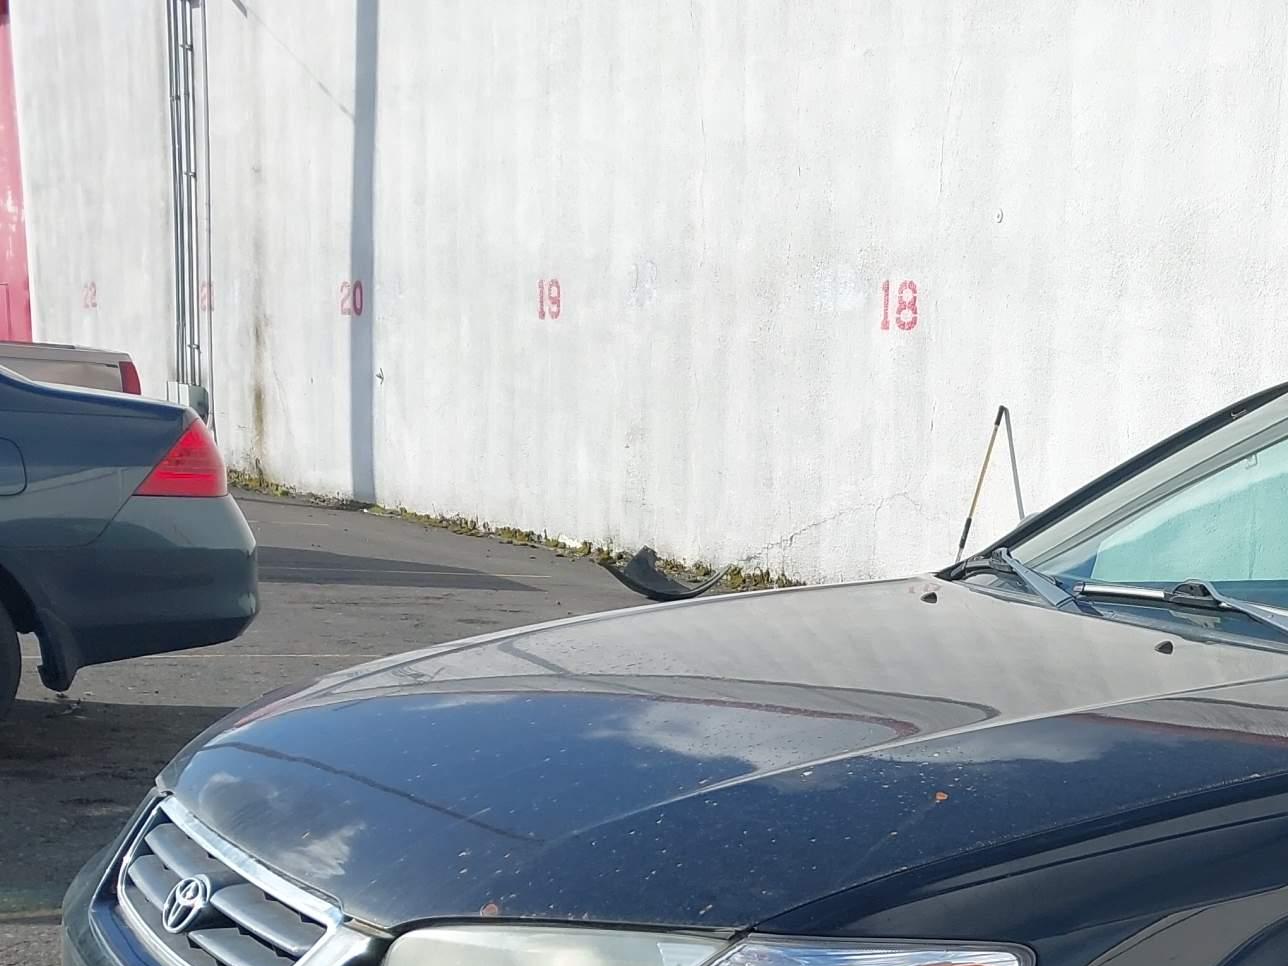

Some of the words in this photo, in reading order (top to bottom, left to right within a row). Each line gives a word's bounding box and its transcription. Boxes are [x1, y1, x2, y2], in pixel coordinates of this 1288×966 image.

[340, 280, 363, 316] 20
[538, 279, 561, 320] 19
[880, 279, 918, 331] 18
